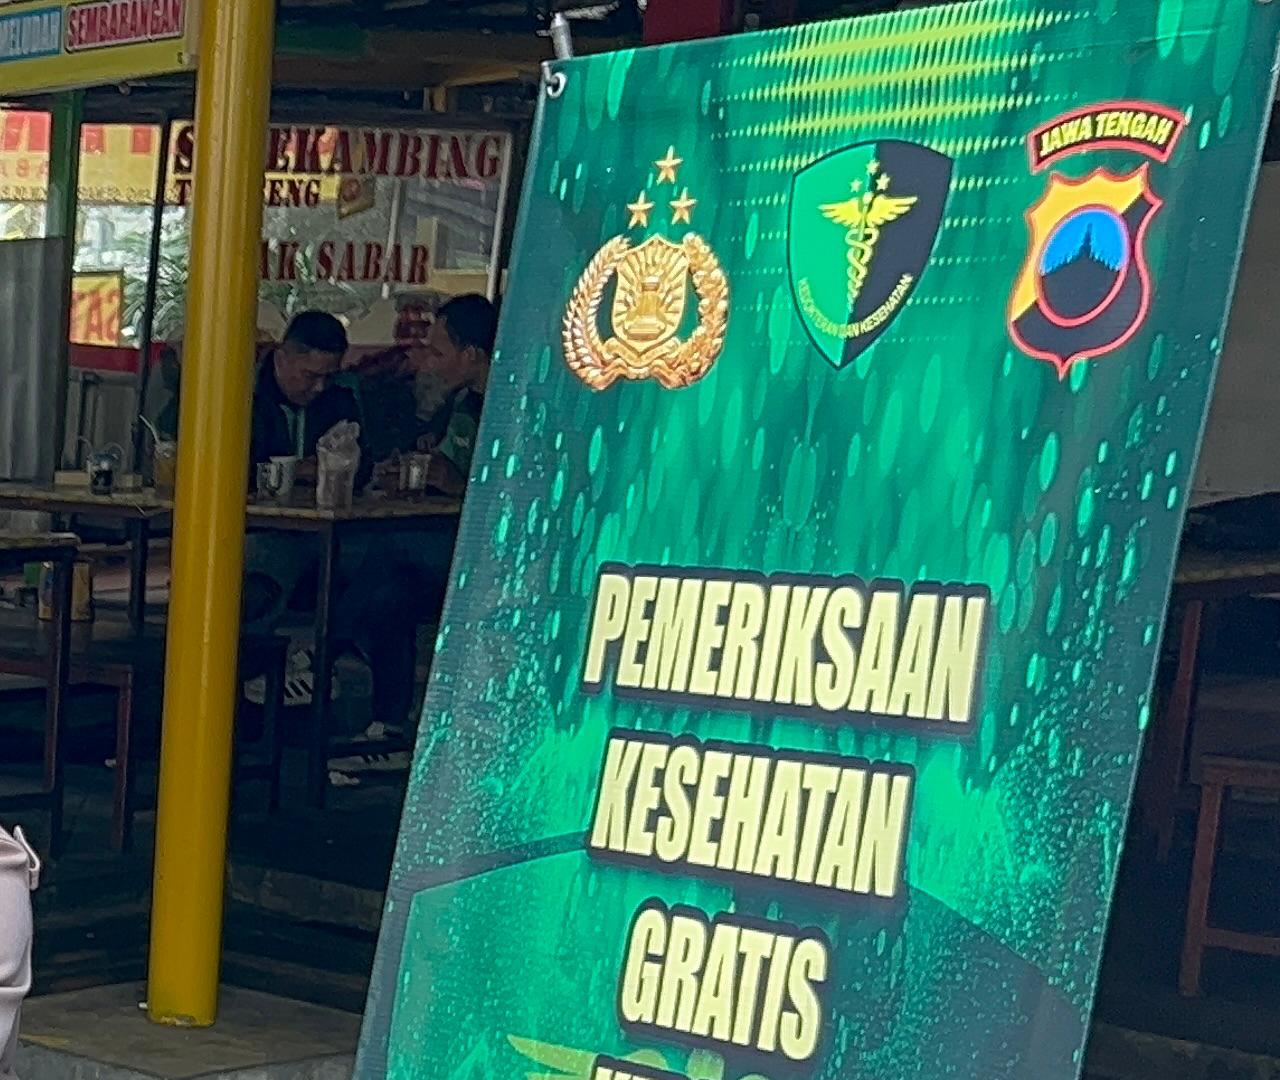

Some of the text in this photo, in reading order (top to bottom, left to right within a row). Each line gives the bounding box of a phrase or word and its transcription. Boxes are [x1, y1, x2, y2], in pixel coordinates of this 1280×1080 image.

[1037, 108, 1173, 158] JAWA TENGAH
[316, 240, 431, 285] SABAR
[583, 572, 988, 725] PEMERIKSAAN
[589, 736, 913, 899] KESEHATAN
[620, 904, 829, 1063] GRATIS
